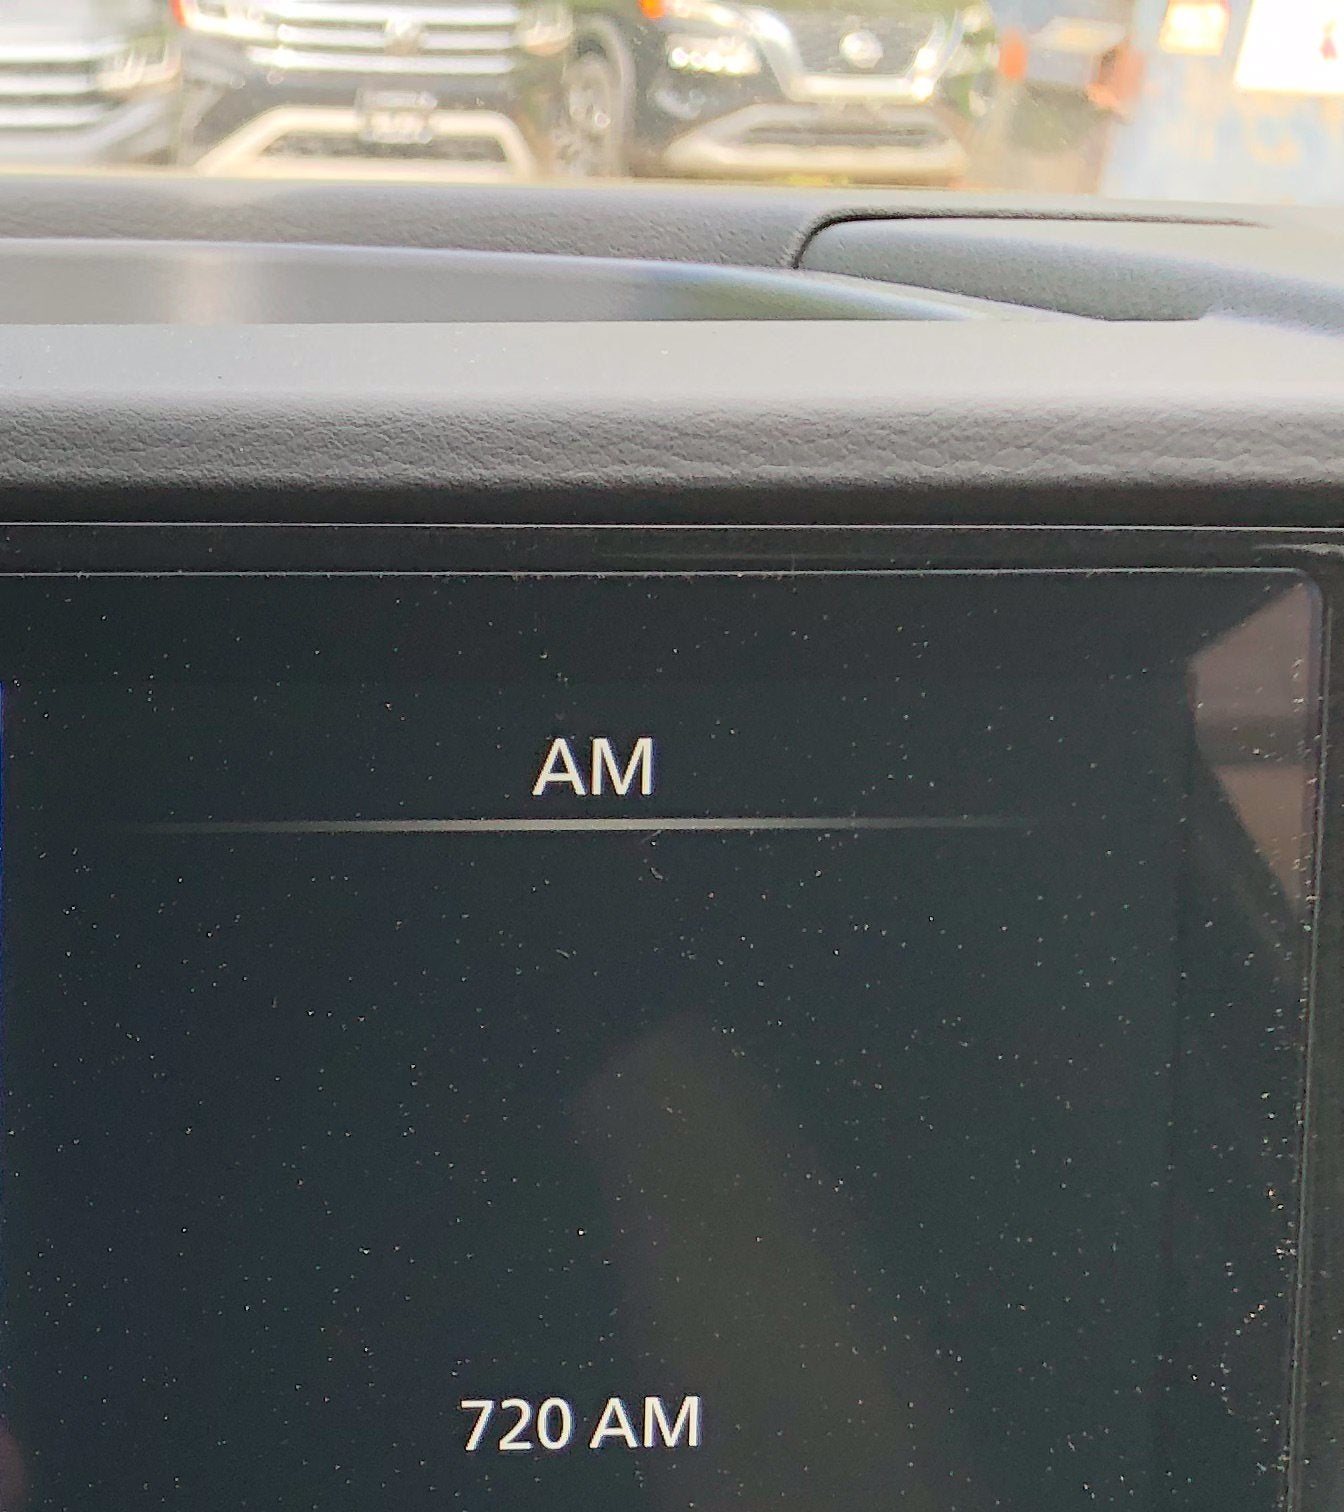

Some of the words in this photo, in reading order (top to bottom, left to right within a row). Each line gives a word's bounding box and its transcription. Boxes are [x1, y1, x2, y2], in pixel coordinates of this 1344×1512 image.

[531, 737, 655, 796] AM
[460, 1398, 573, 1451] 720
[589, 1395, 702, 1448] AM
